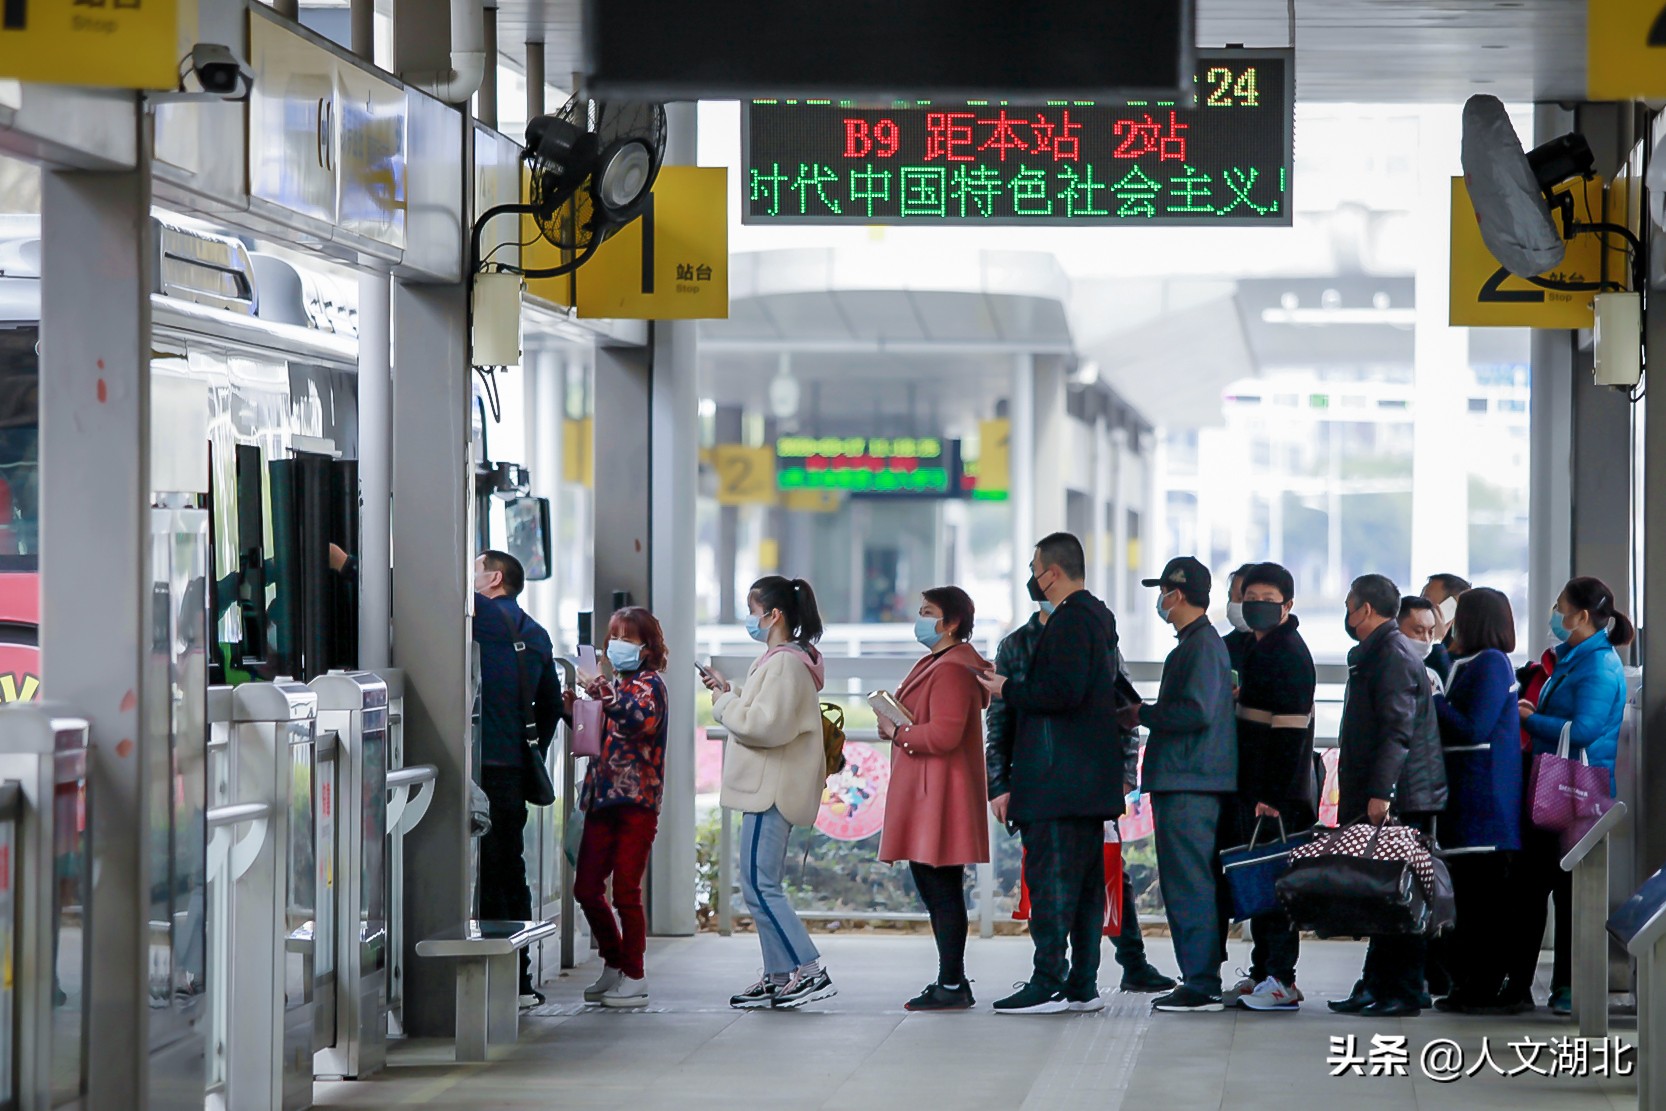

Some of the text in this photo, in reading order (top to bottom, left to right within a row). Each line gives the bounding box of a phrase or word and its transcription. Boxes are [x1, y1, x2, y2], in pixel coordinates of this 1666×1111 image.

[843, 110, 1189, 162] B9 距本站 2站
[750, 163, 1286, 218] 时代中国特色社会主义
[676, 263, 713, 281] 站台
[676, 284, 700, 294] Stop
[1549, 292, 1573, 303] Stop
